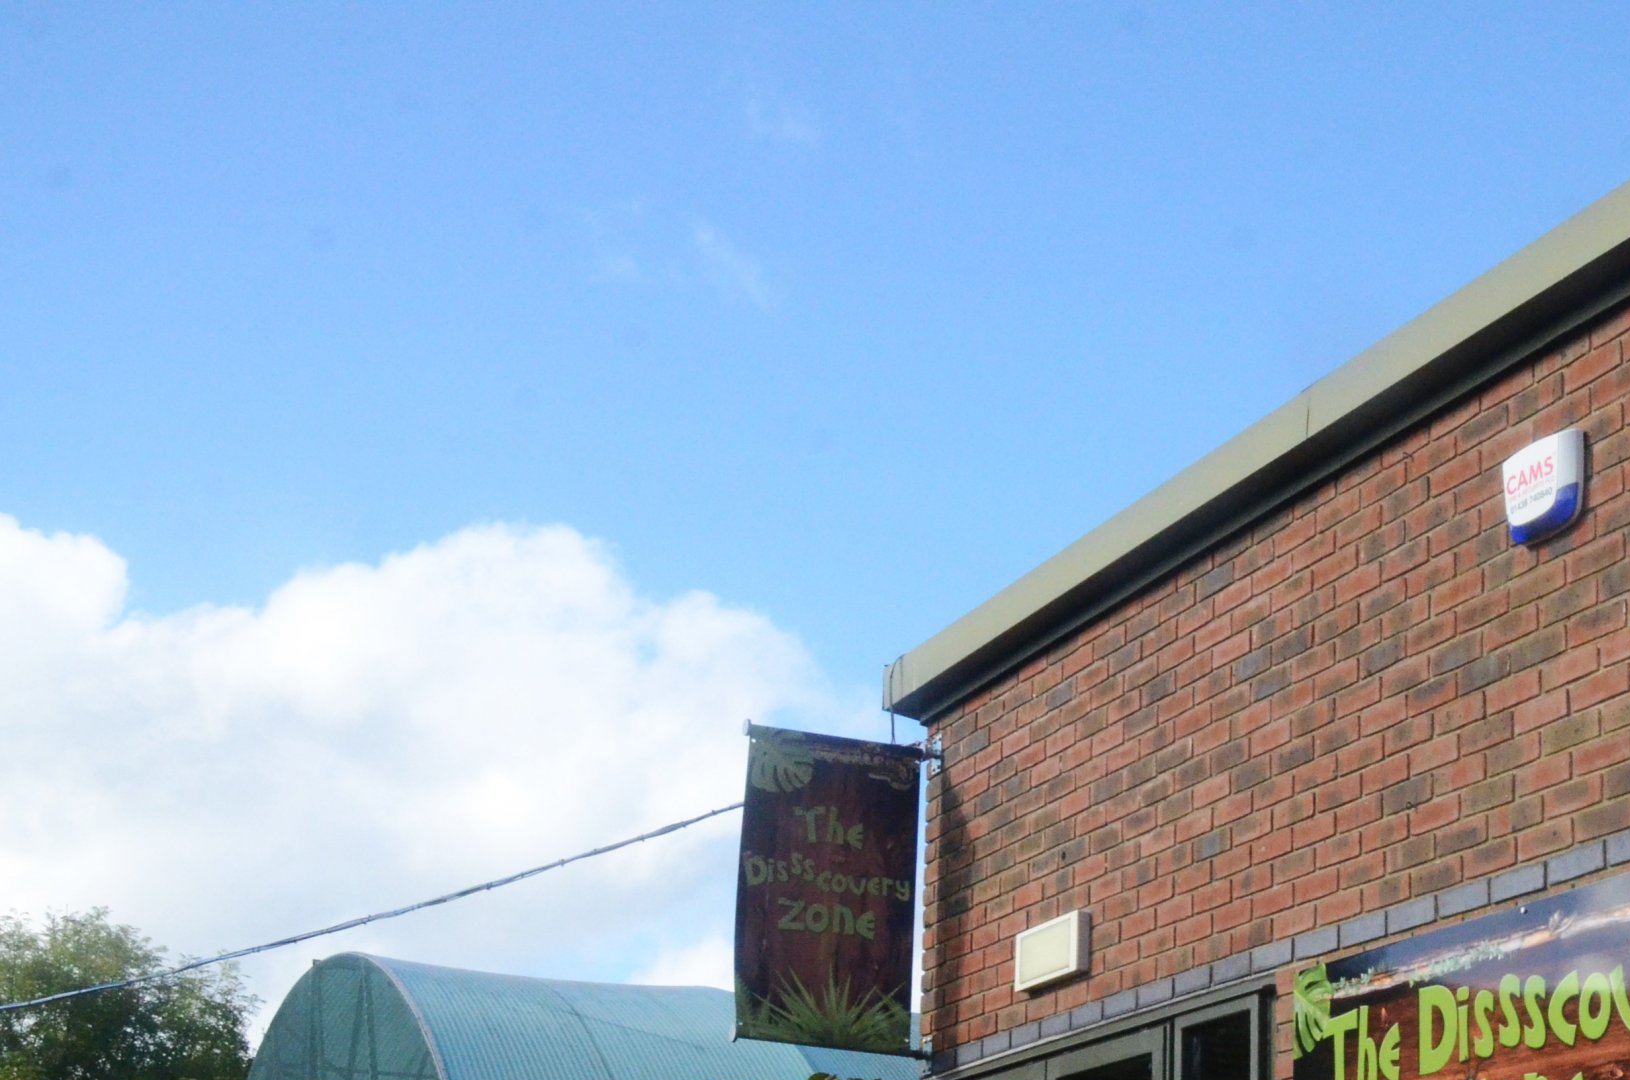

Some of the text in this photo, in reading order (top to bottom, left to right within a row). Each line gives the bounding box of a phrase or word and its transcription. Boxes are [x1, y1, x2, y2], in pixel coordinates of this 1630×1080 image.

[1506, 456, 1554, 495] CAMS
[793, 805, 864, 850] The
[777, 898, 876, 940] Zone
